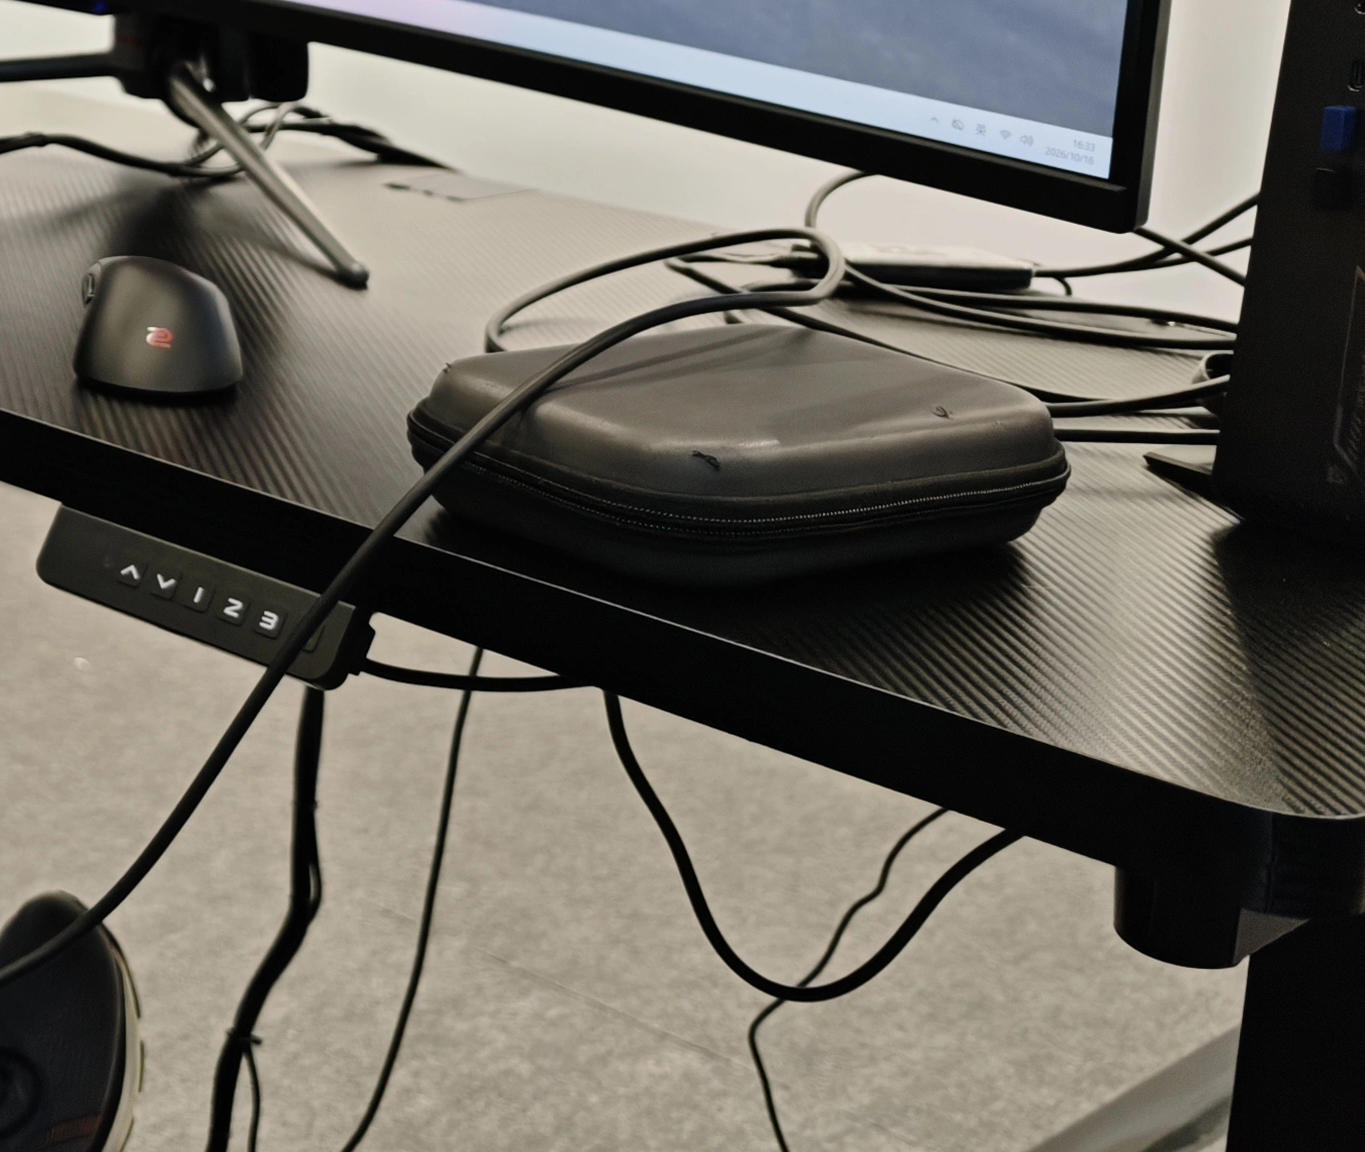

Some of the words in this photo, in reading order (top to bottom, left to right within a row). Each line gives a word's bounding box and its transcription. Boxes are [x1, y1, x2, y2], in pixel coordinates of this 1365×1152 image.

[193, 586, 204, 603] 1
[223, 598, 243, 618] 2
[259, 610, 279, 630] 3
